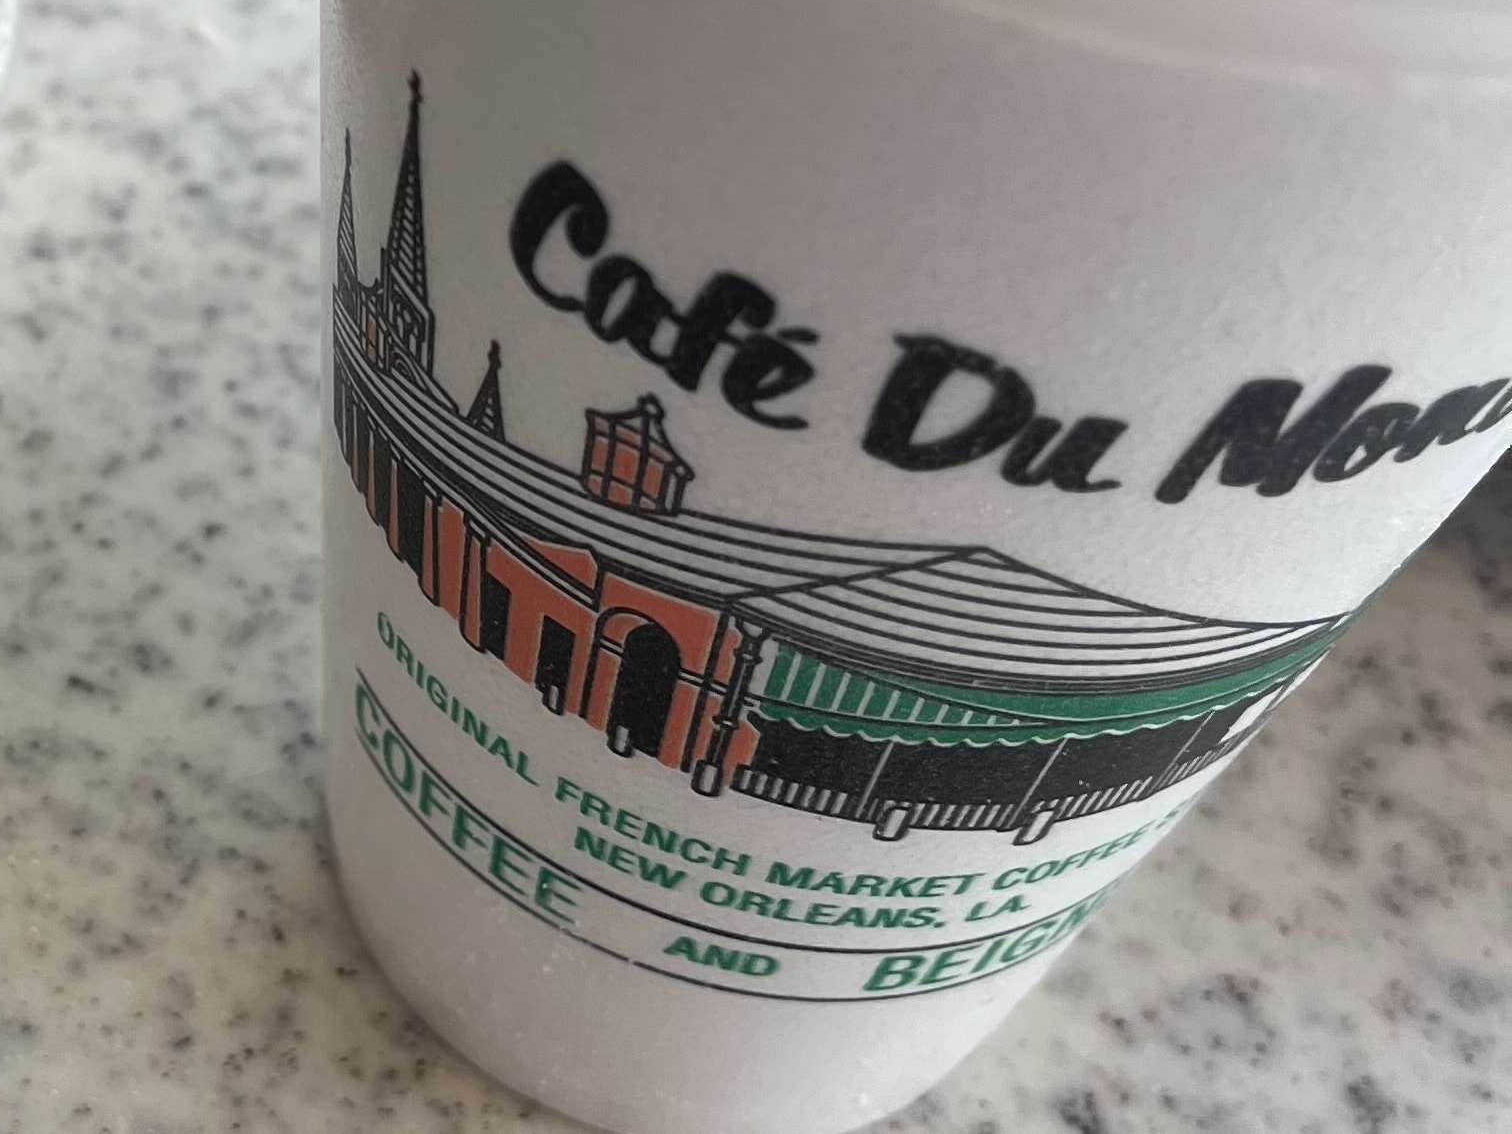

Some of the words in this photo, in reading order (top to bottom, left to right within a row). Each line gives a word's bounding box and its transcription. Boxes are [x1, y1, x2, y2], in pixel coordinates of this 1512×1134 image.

[509, 160, 818, 430] Café
[862, 332, 1128, 492] Du
[355, 681, 584, 926] COFFEE
[663, 935, 780, 978] AND
[377, 611, 539, 787] ORIGINAL
[554, 777, 752, 876] FRENCH
[764, 861, 987, 899] MARKET
[992, 819, 1157, 891] COFFEE
[574, 825, 688, 891] NEW
